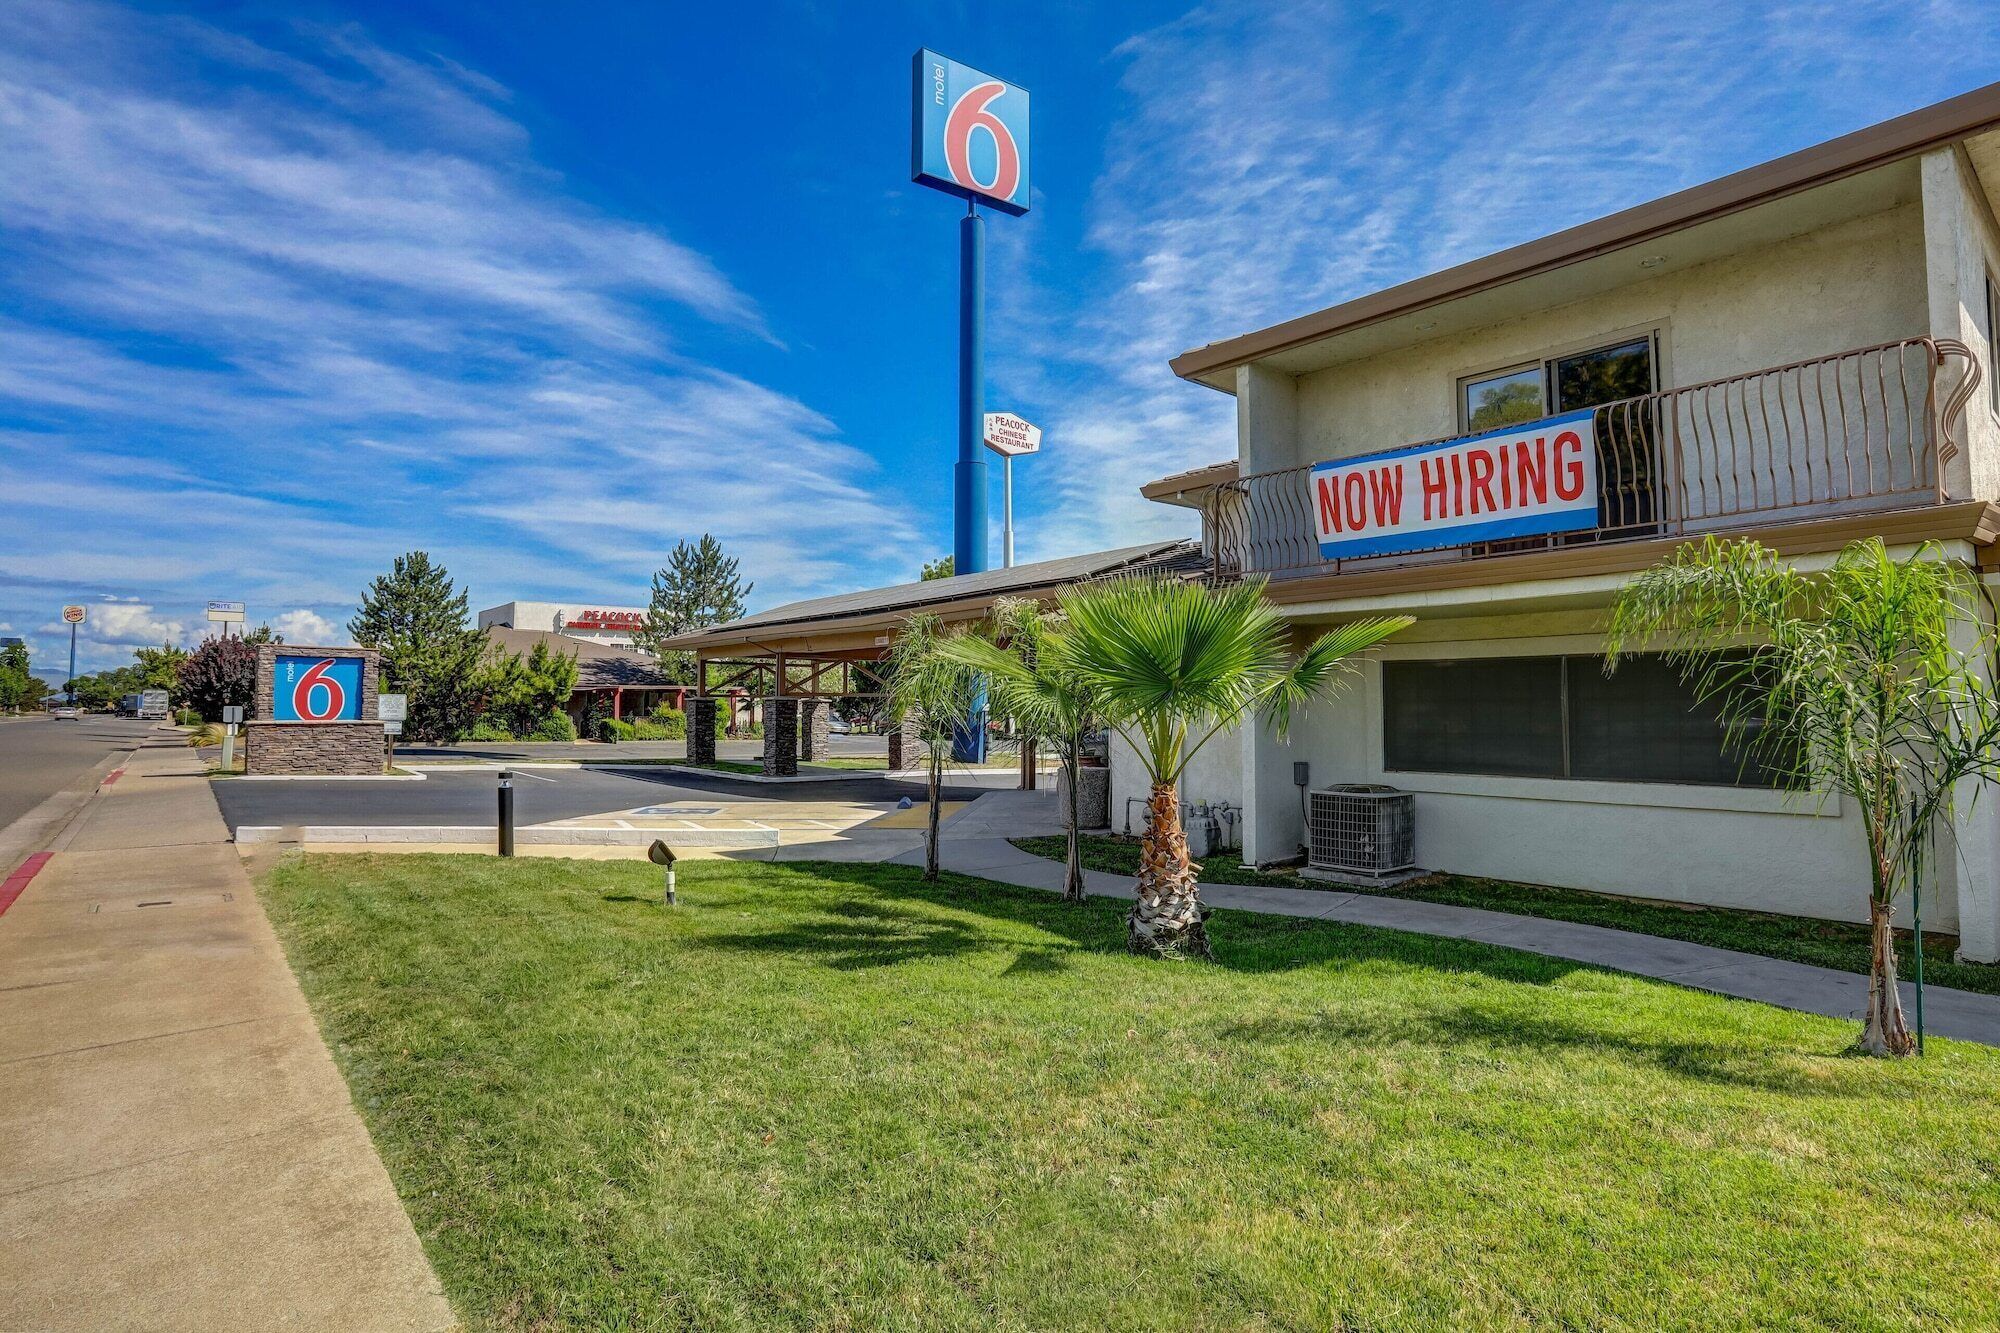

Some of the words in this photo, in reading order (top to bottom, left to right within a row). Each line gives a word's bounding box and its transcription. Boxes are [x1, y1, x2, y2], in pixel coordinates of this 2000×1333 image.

[933, 63, 945, 105] motel
[944, 81, 1020, 201] 6
[995, 416, 1030, 432] PEACOCK
[990, 433, 1034, 450] RESTAURANT
[998, 427, 1027, 441] CHINESE
[1318, 464, 1403, 535] NOW
[1420, 431, 1585, 521] HIRING
[66, 611, 83, 619] KING
[583, 610, 641, 622] PEACOCK
[286, 661, 295, 682] motel
[292, 658, 345, 720] 6
